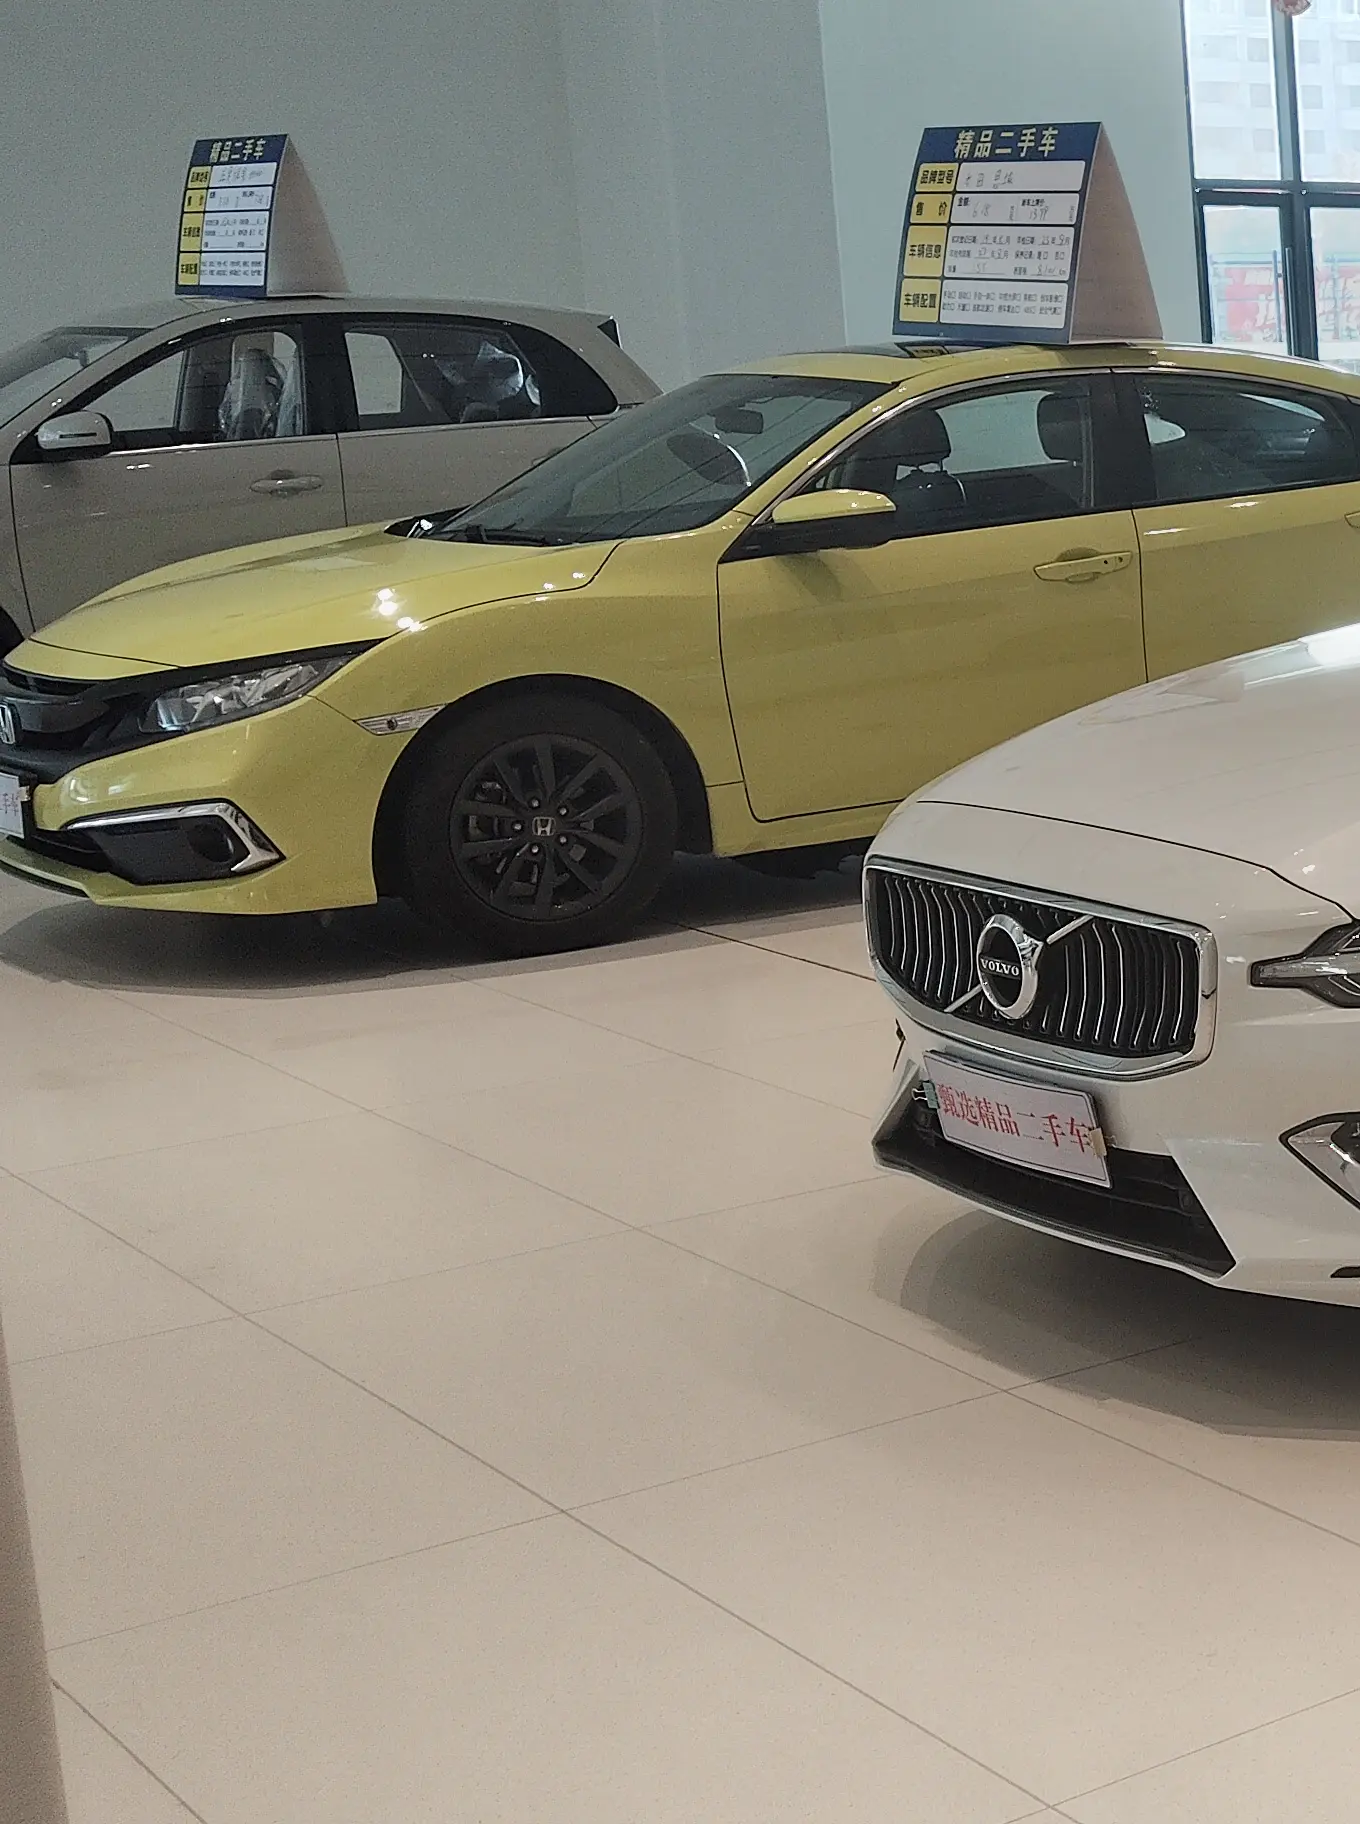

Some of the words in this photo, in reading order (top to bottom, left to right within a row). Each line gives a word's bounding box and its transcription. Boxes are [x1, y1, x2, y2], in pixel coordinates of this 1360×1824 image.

[954, 127, 1058, 159] 精品二手车
[980, 959, 1020, 976] VOLVO
